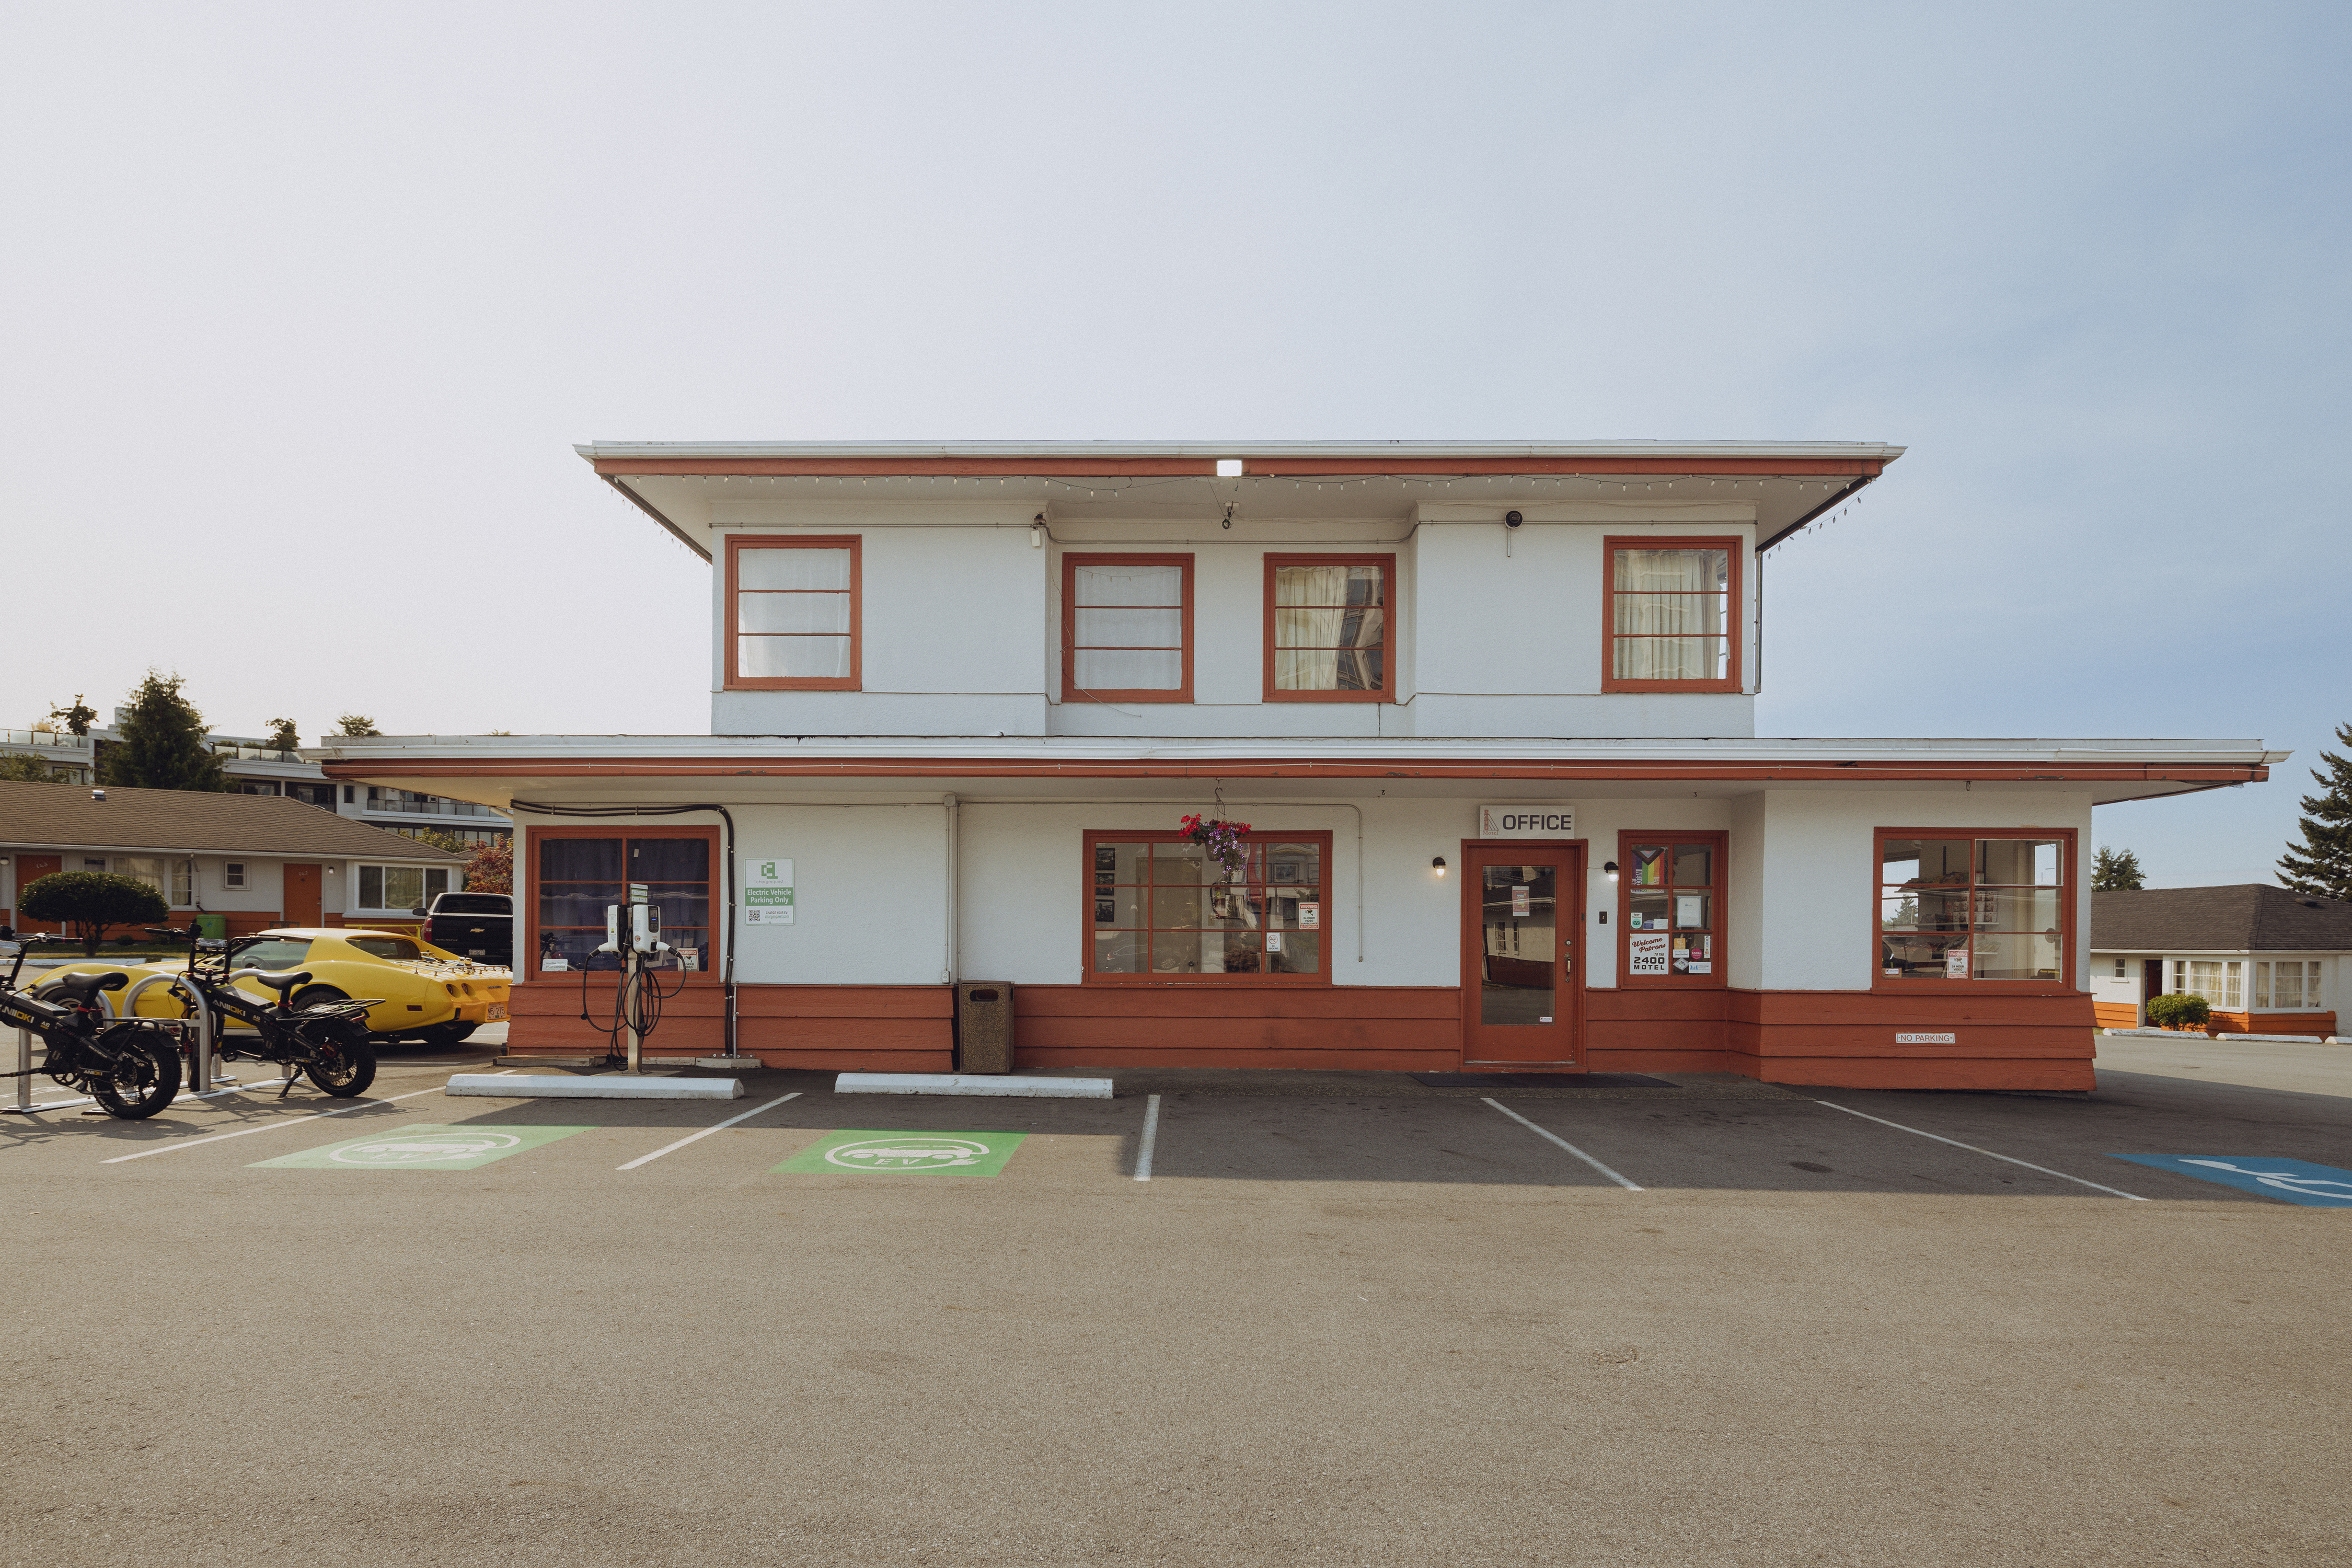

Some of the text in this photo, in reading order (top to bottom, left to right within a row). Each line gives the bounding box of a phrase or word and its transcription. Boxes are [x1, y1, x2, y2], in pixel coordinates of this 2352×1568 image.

[1503, 814, 1572, 830] OFFICE
[1632, 938, 1663, 947] Welcome
[1639, 943, 1666, 953] Patrons
[213, 999, 246, 1017] ANIIOKI
